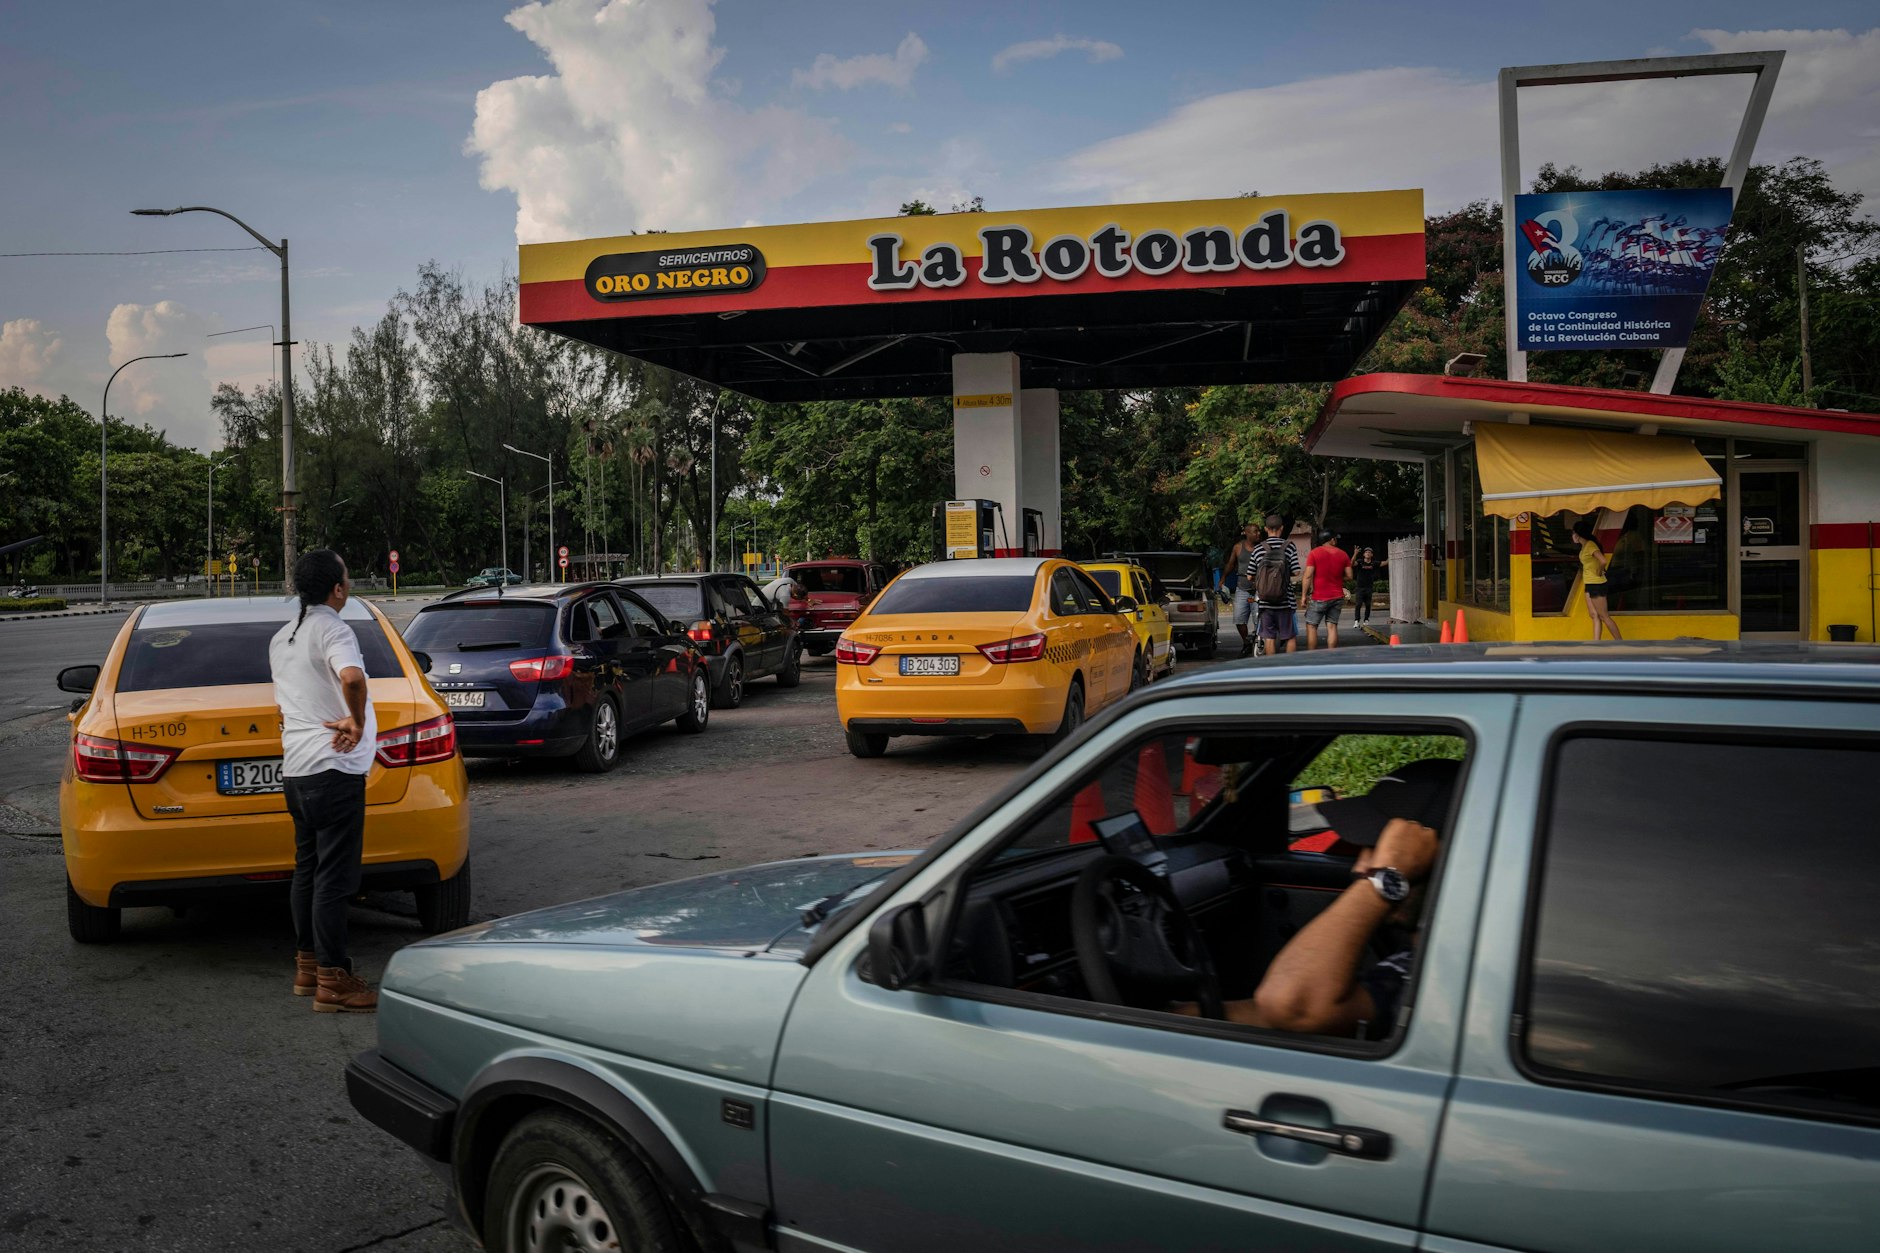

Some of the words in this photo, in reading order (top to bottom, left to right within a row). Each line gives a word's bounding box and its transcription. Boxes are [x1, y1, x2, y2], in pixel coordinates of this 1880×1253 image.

[866, 232, 967, 290] La
[978, 208, 1346, 284] Rotonda
[658, 249, 748, 267] SERVICENTROS
[595, 273, 650, 294] ORO
[656, 266, 749, 290] NEGRO
[1543, 274, 1569, 284] PCC
[1527, 312, 1566, 321] Octavo
[1567, 311, 1618, 321] Congreso
[1528, 323, 1542, 332] de
[1544, 323, 1555, 332] la
[1557, 321, 1621, 331] Continuidad
[1623, 320, 1671, 330] Histórica
[1528, 334, 1542, 343] de
[1544, 334, 1556, 343] la
[1557, 332, 1617, 343] Revolución
[1618, 332, 1660, 341] Cubana
[908, 659, 915, 671] B
[916, 659, 935, 671] 204
[937, 659, 957, 671] 303
[464, 693, 482, 706] 946
[132, 722, 187, 740] H-5109
[233, 765, 246, 787] B
[249, 763, 283, 787] 206
